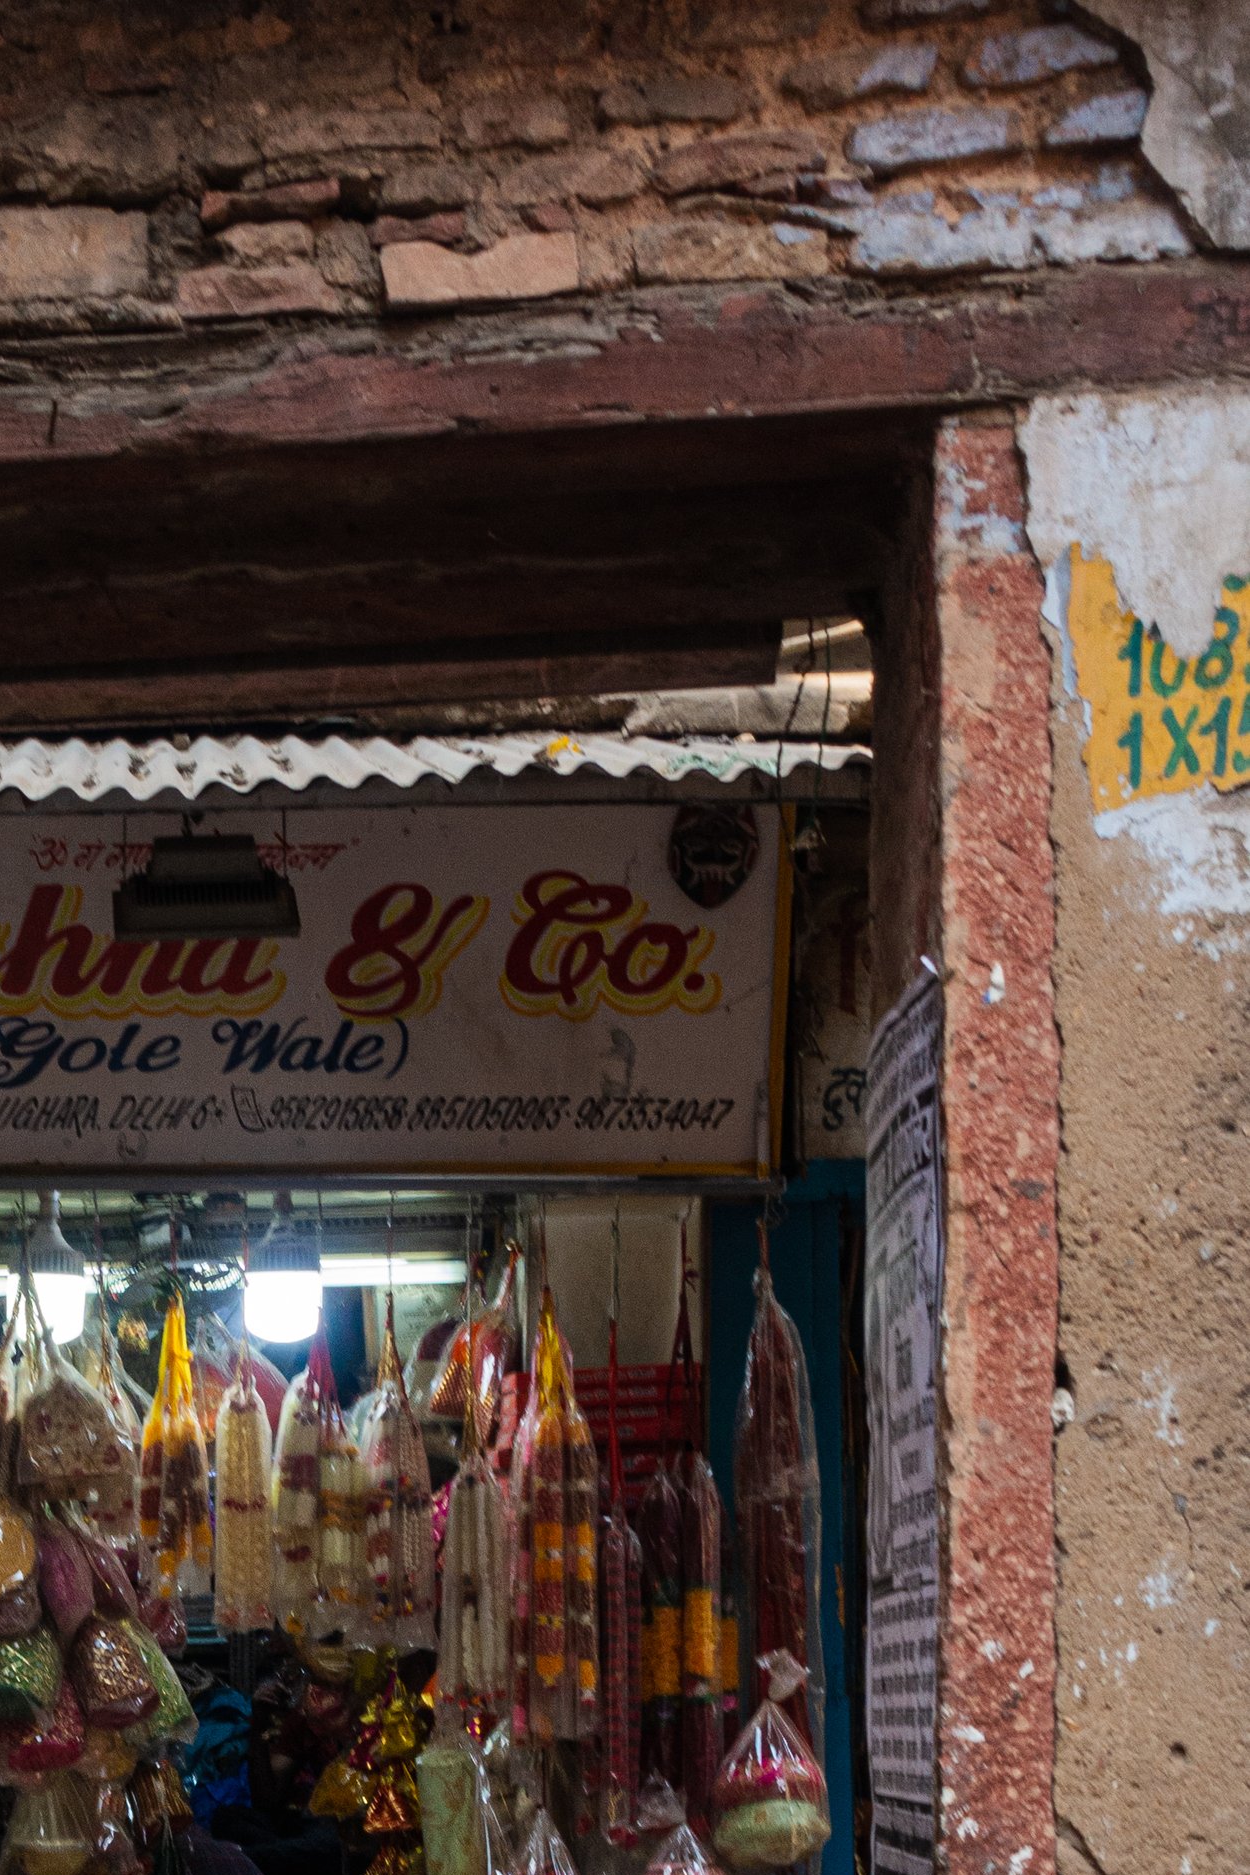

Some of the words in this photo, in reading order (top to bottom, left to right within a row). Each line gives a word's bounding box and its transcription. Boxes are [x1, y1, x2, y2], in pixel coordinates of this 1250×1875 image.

[324, 883, 490, 1023] &
[499, 868, 722, 1020] Co.
[212, 1018, 410, 1080] Wale)
